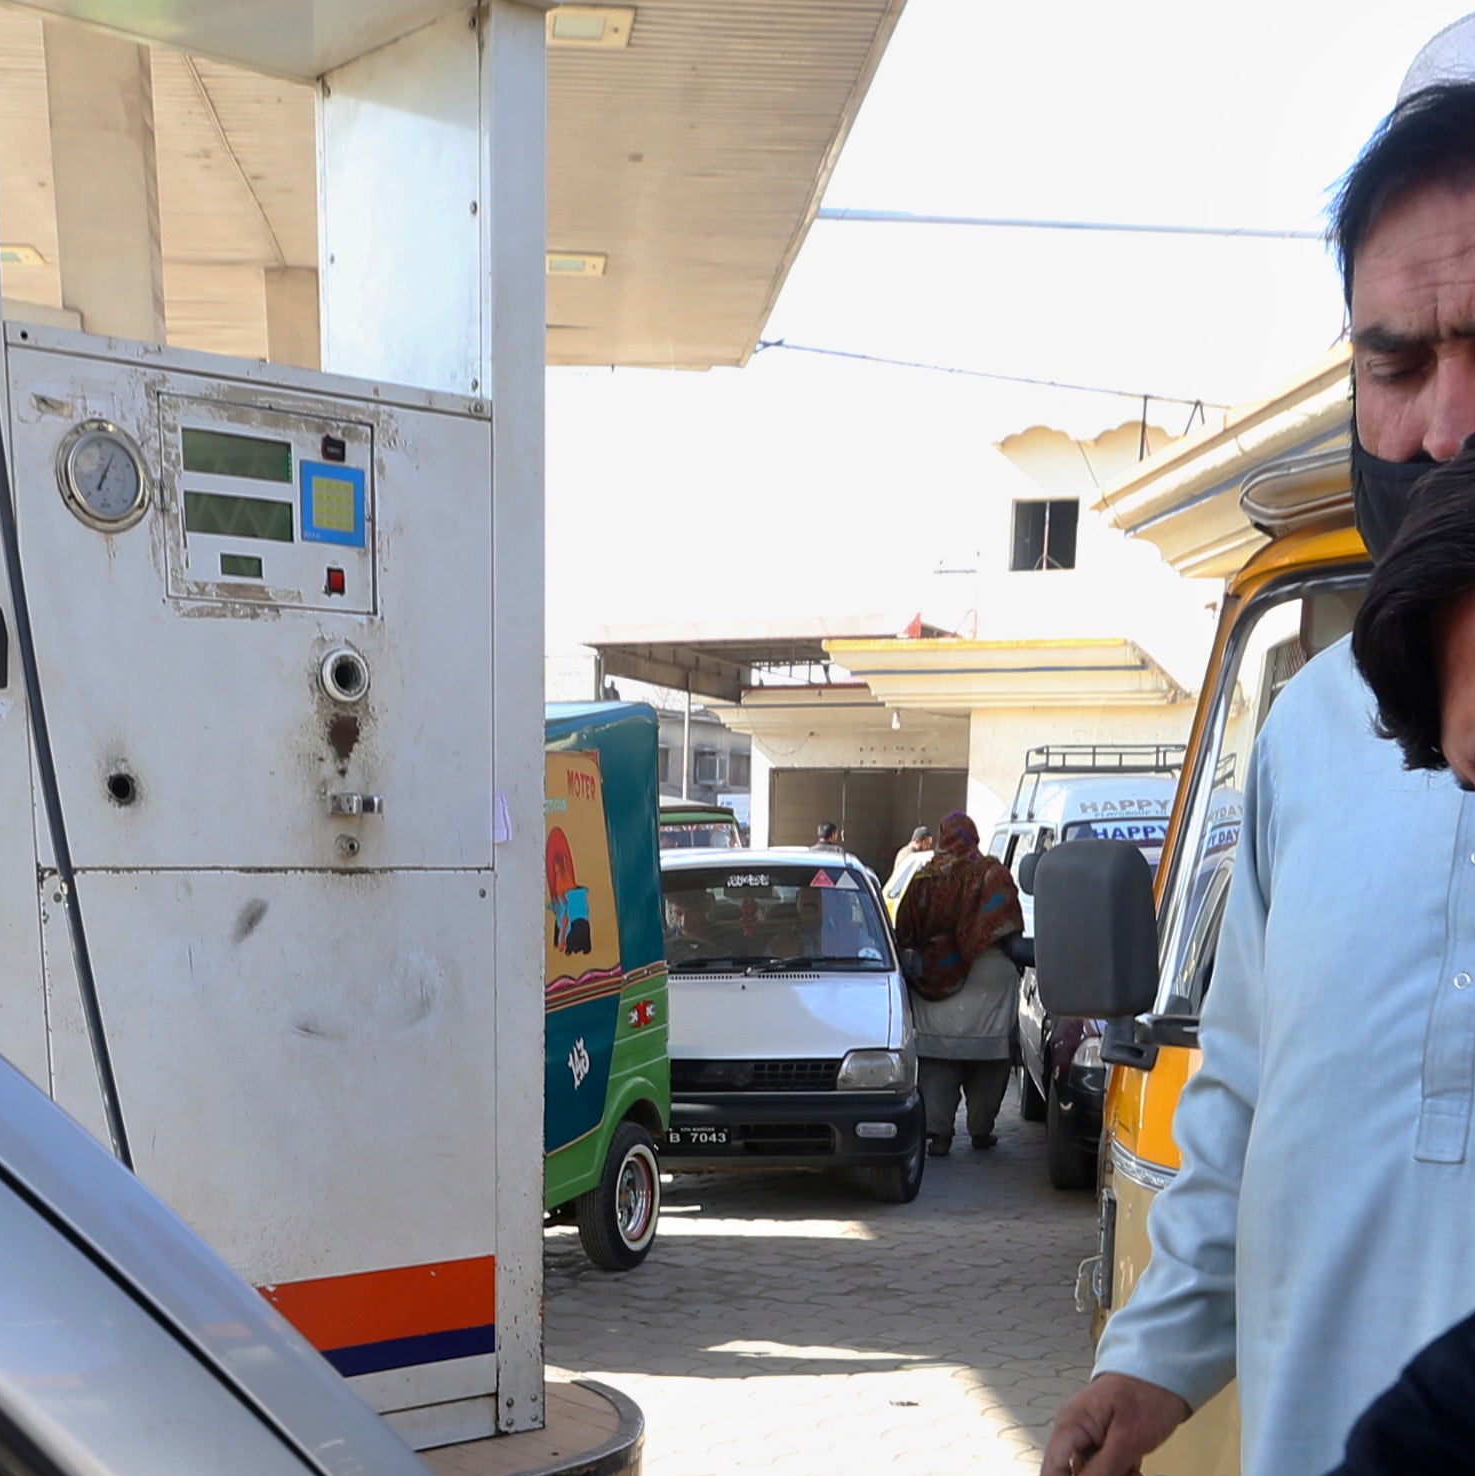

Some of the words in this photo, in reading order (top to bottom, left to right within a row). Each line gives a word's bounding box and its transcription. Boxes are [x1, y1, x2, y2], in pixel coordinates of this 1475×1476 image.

[1080, 799, 1170, 813] HAPPY
[1218, 828, 1240, 843] DAY
[689, 1132, 726, 1143] 7043
